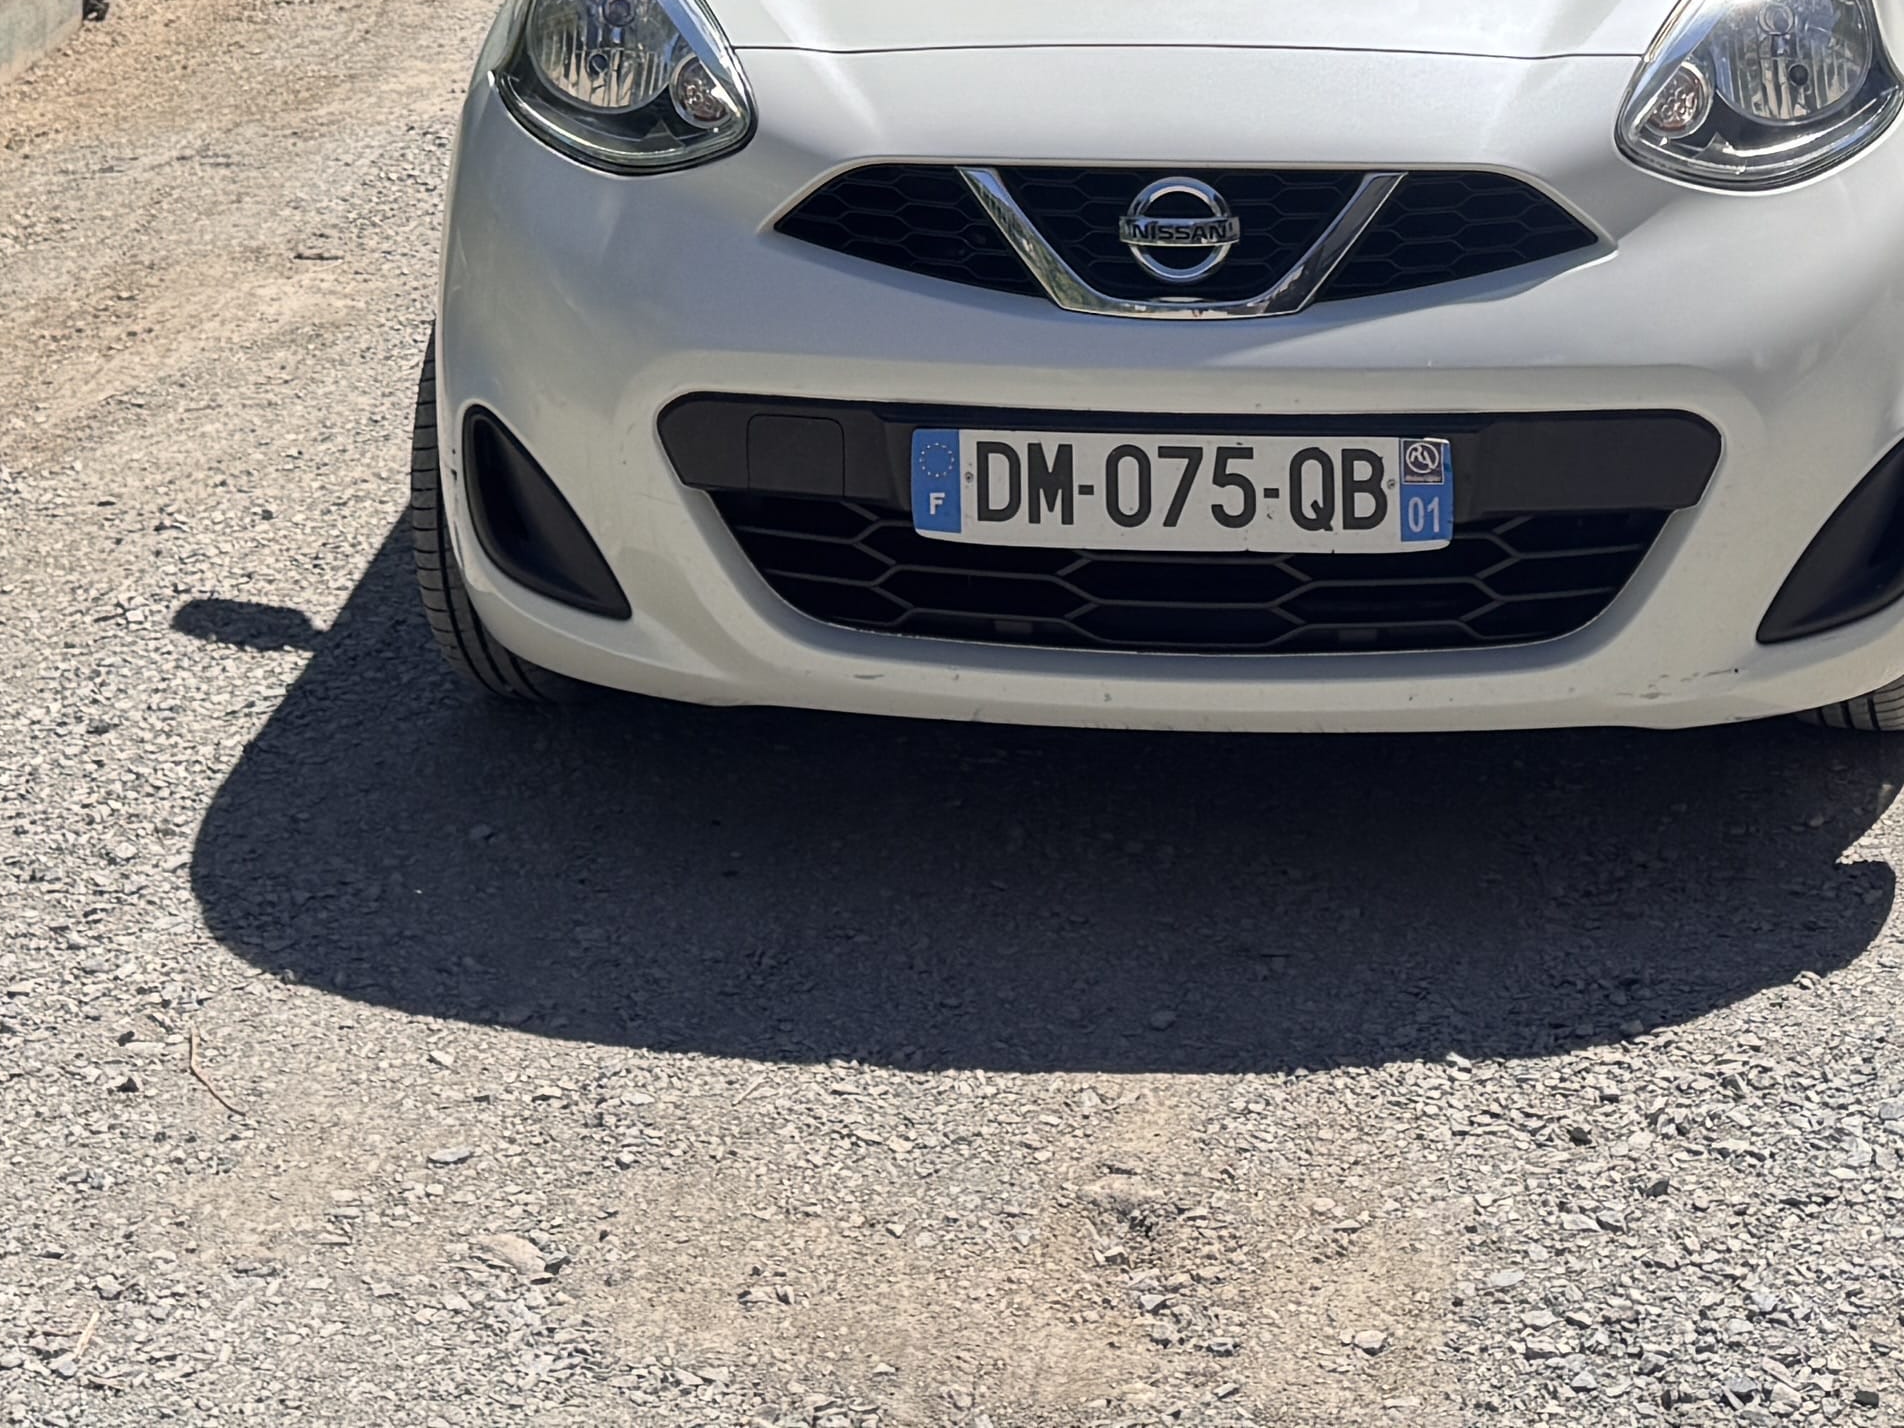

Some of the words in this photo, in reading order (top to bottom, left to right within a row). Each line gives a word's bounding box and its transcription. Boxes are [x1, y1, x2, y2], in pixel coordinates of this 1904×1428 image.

[1131, 222, 1227, 240] NISSAN
[975, 440, 1388, 532] DM-075-QB
[929, 492, 944, 515] F
[1408, 496, 1440, 533] 01
